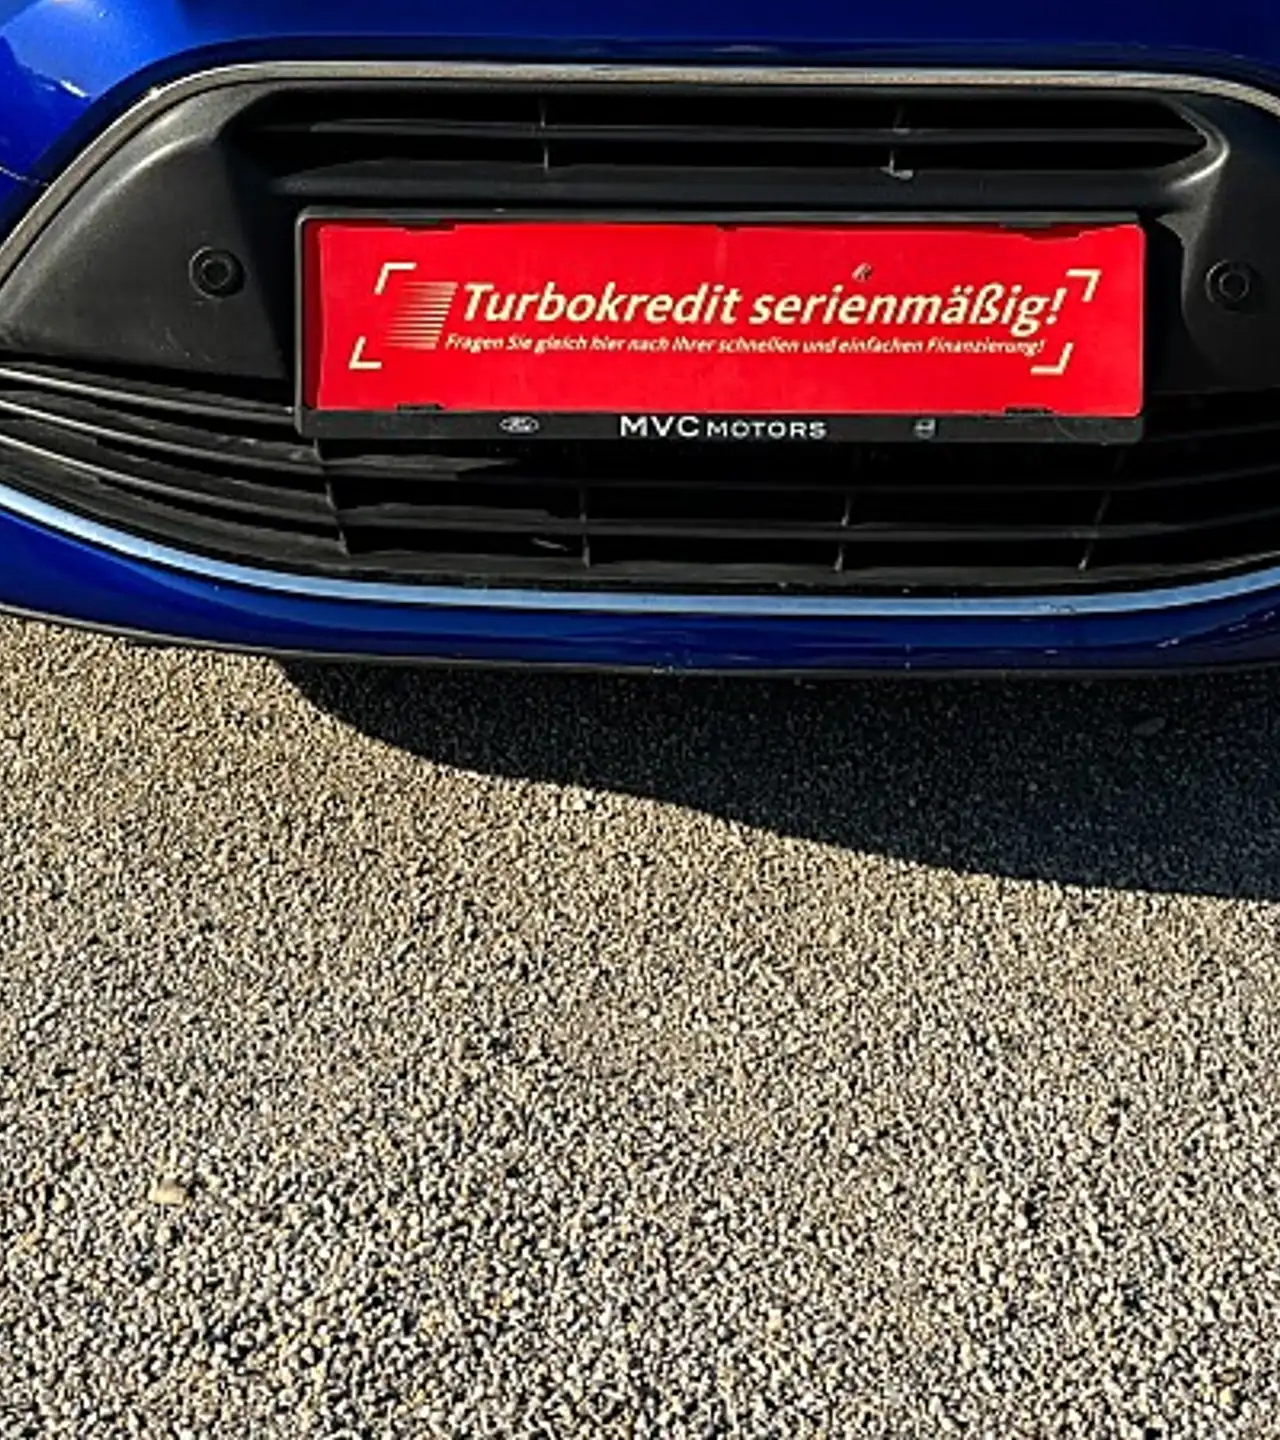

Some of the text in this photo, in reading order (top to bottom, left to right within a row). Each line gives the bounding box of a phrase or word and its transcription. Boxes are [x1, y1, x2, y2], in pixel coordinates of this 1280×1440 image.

[463, 281, 1067, 337] Turbokredit serienmäßig!
[445, 334, 504, 353] Fragen
[506, 334, 533, 350] Sie
[534, 334, 587, 354] gleich
[627, 336, 670, 352] nach
[717, 337, 799, 353] schnellen
[802, 338, 836, 353] und
[838, 337, 923, 353] einfachen
[926, 337, 1046, 357] Finanzierung!
[620, 415, 827, 439] MVC MOTORS
